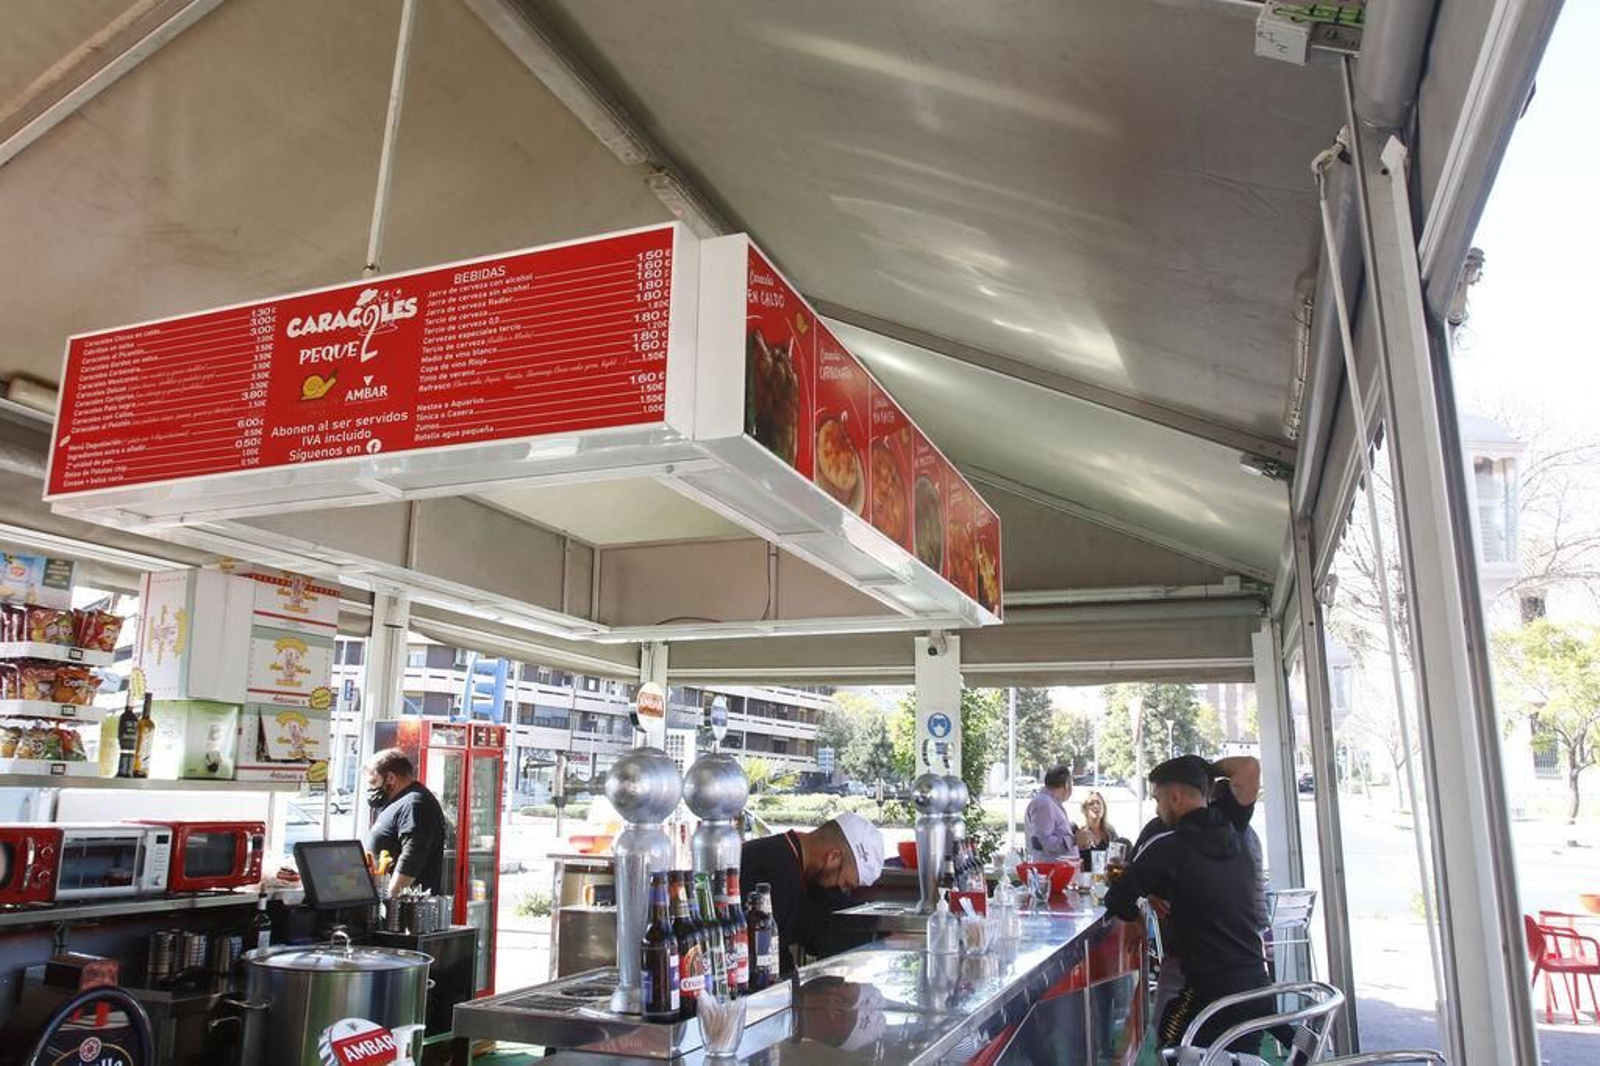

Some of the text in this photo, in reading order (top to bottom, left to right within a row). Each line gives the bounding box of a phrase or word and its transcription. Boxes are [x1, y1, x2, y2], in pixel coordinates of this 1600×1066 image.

[454, 265, 506, 284] BEBIDAS
[459, 283, 488, 292] cerveza
[506, 274, 532, 284] alcohol
[459, 292, 487, 301] cerveza
[502, 283, 530, 294] alcohol
[458, 302, 486, 311] cerveza
[488, 297, 513, 305] Radler
[459, 311, 488, 320] cerveza
[458, 320, 486, 330] cerveza
[423, 334, 456, 344] Cervezas
[456, 339, 485, 348] cerveza
[450, 370, 475, 378] verano
[345, 385, 387, 401] AMBAR
[417, 404, 442, 412] Nestea
[271, 412, 408, 437] Abonen al ser servidos
[302, 429, 372, 446] IVA incluido
[289, 446, 342, 462] Síguenos
[346, 445, 361, 454] en
[342, 1033, 397, 1063] AMBAR
